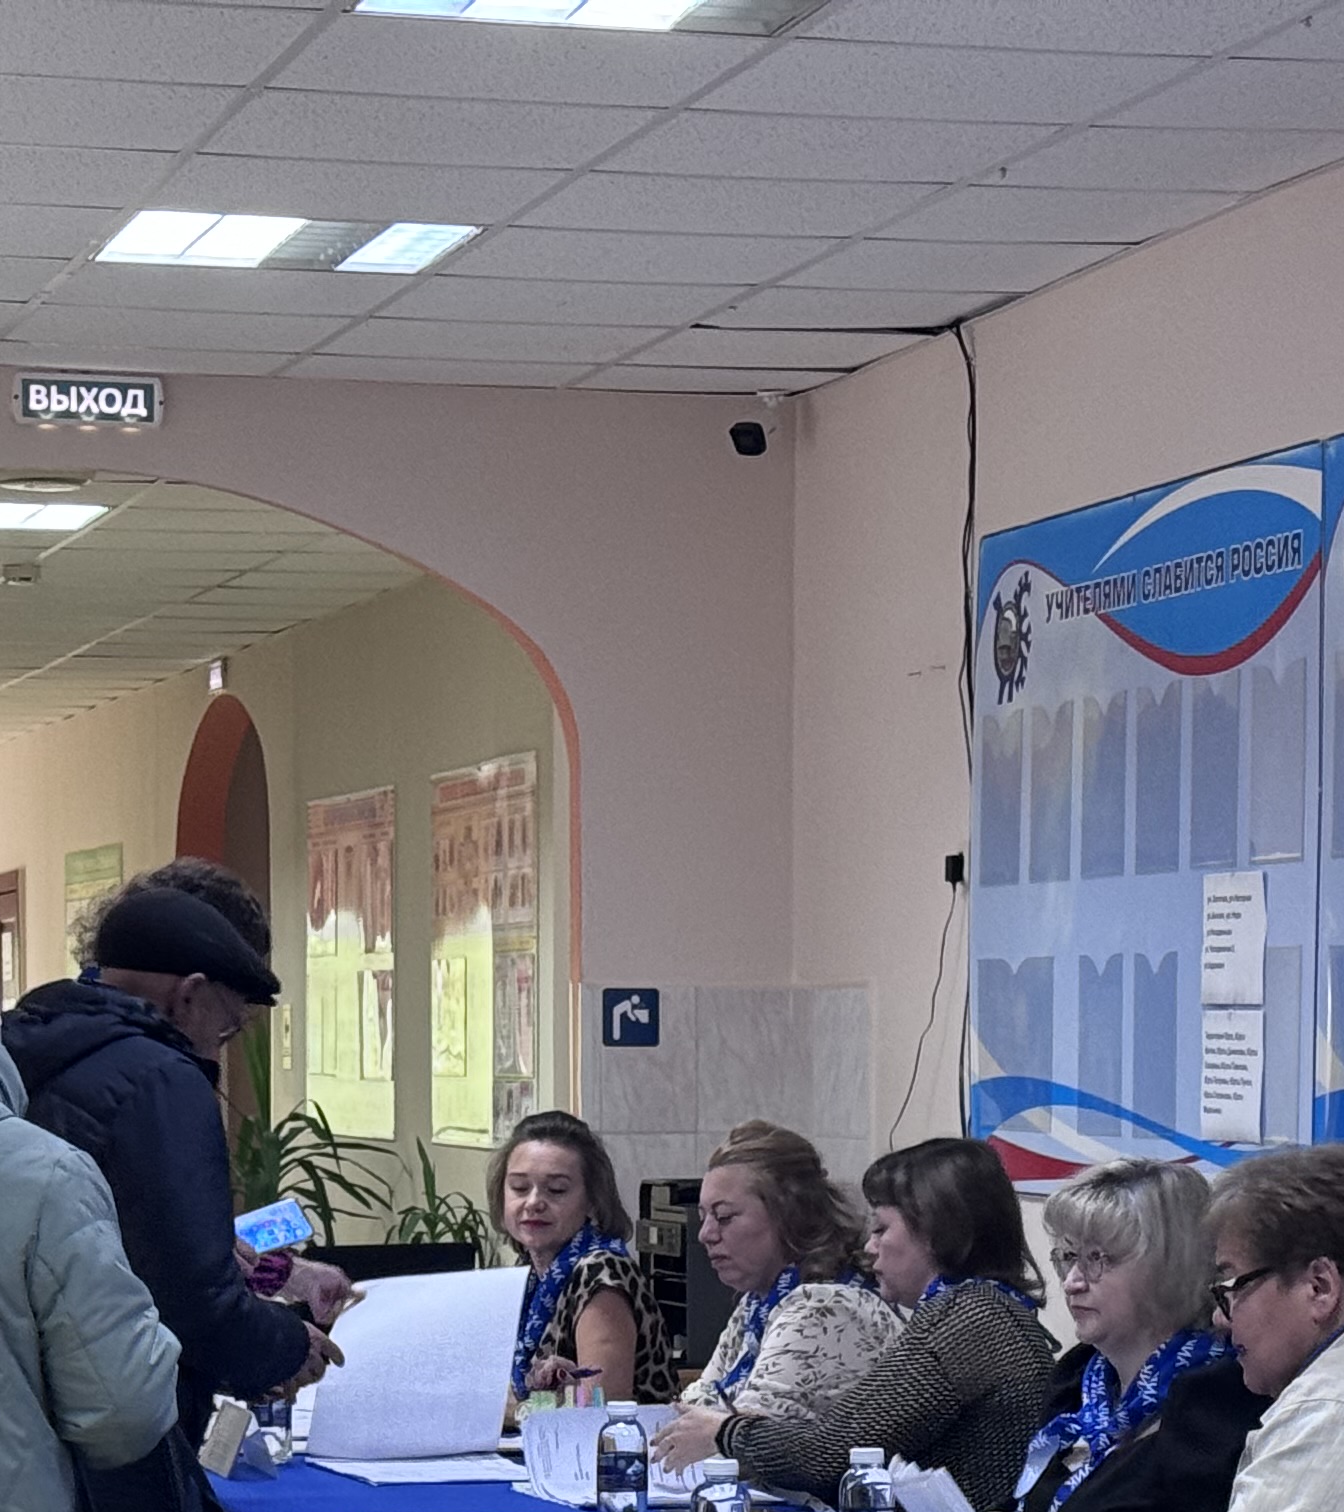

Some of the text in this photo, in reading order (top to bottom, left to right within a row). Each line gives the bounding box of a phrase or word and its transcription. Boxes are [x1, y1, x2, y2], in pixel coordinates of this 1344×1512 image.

[28, 384, 148, 417] ВЫХОД
[1045, 529, 1304, 624] УЧИТЕЛЯМИ СЛАВИТСЯ РОССИЯ
